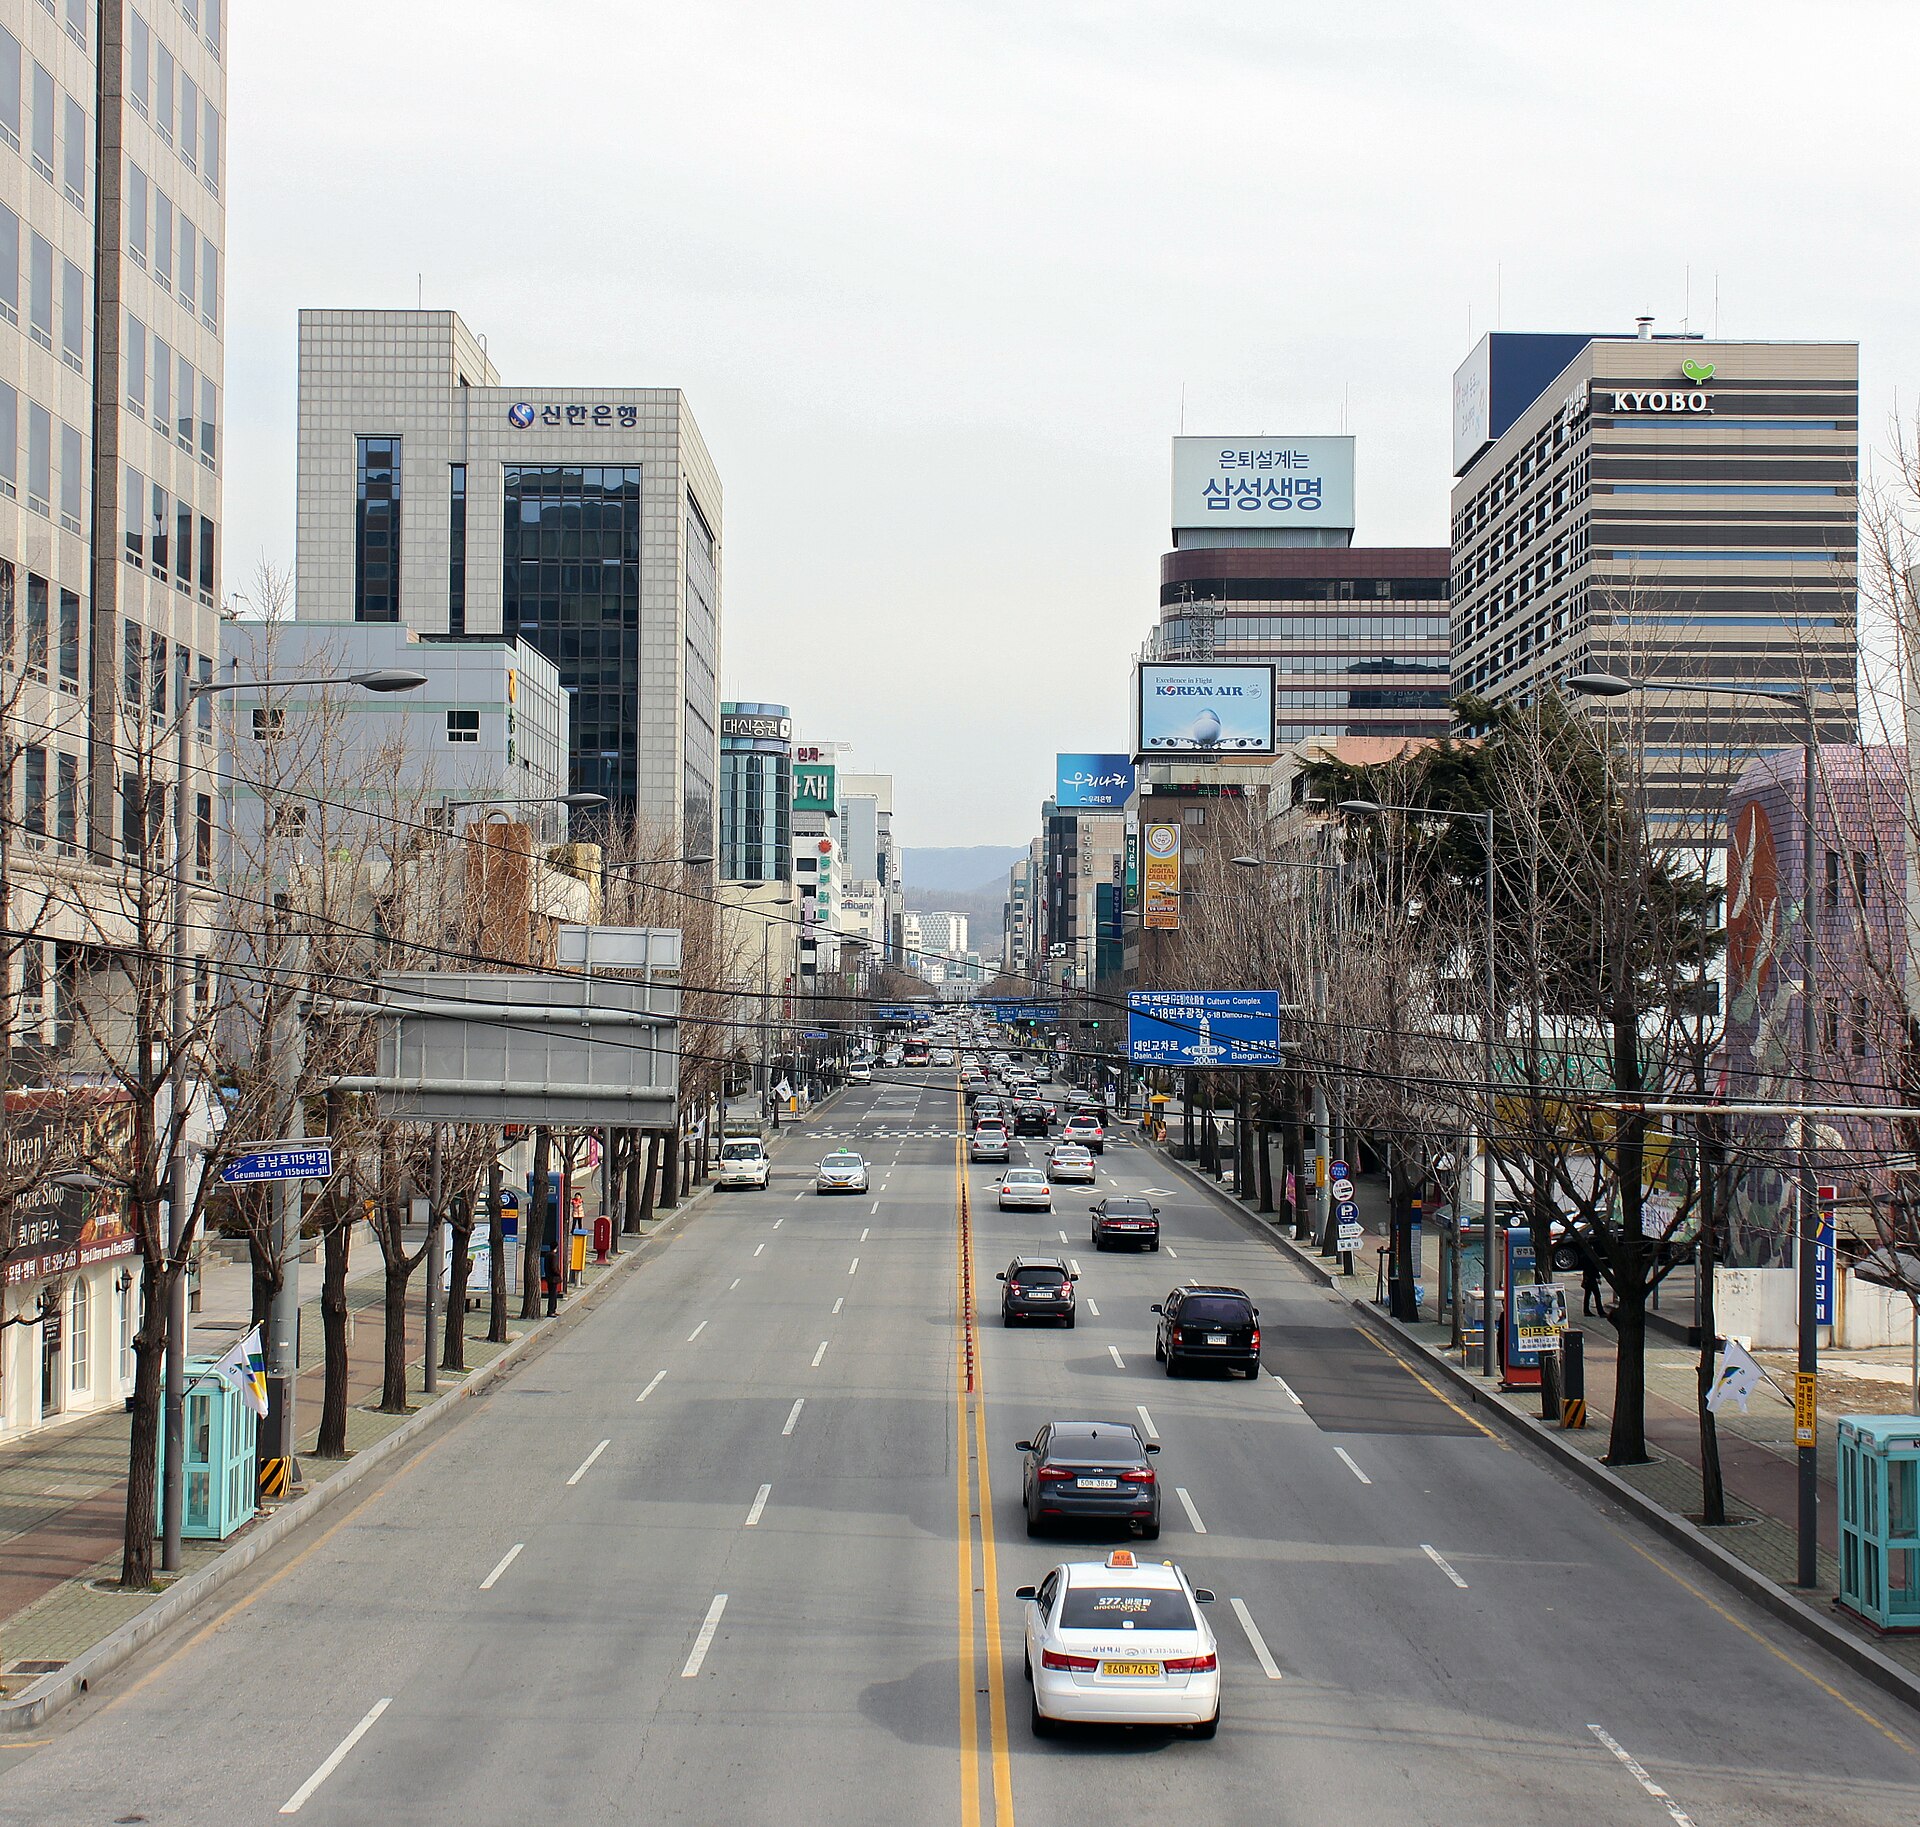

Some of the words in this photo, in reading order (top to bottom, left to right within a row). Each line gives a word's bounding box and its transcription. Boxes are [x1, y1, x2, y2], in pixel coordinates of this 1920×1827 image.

[1614, 391, 1707, 412] KYOBO
[541, 405, 638, 428] 신한은행
[1218, 450, 1310, 470] 은퇴설계는
[1201, 476, 1322, 511] 삼성생명
[1155, 676, 1187, 684] Excellence
[1195, 676, 1213, 685] Flight
[1155, 685, 1214, 696] KOREAN
[1215, 686, 1244, 696] AIR
[723, 718, 778, 737] 대신증권
[1062, 771, 1129, 793] 우리나라
[1088, 795, 1112, 804] 우리은행
[1082, 823, 1094, 876] 대우증권
[1128, 838, 1136, 870] 하나은행
[840, 901, 874, 910] citibank
[1232, 998, 1261, 1006] Complex
[1133, 1040, 1179, 1052] 대인교차로
[1133, 1051, 1153, 1060] Daein
[1193, 1056, 1218, 1064] 200m
[1231, 1052, 1263, 1061] Baegun
[256, 1152, 328, 1169] 금남로115번길
[233, 1169, 282, 1179] Geumnam-ro
[284, 1165, 328, 1176] 115beon-gil
[42, 1181, 65, 1207] Shop
[1096, 1479, 1114, 1488] 3862
[1132, 1663, 1157, 1675] 7613
